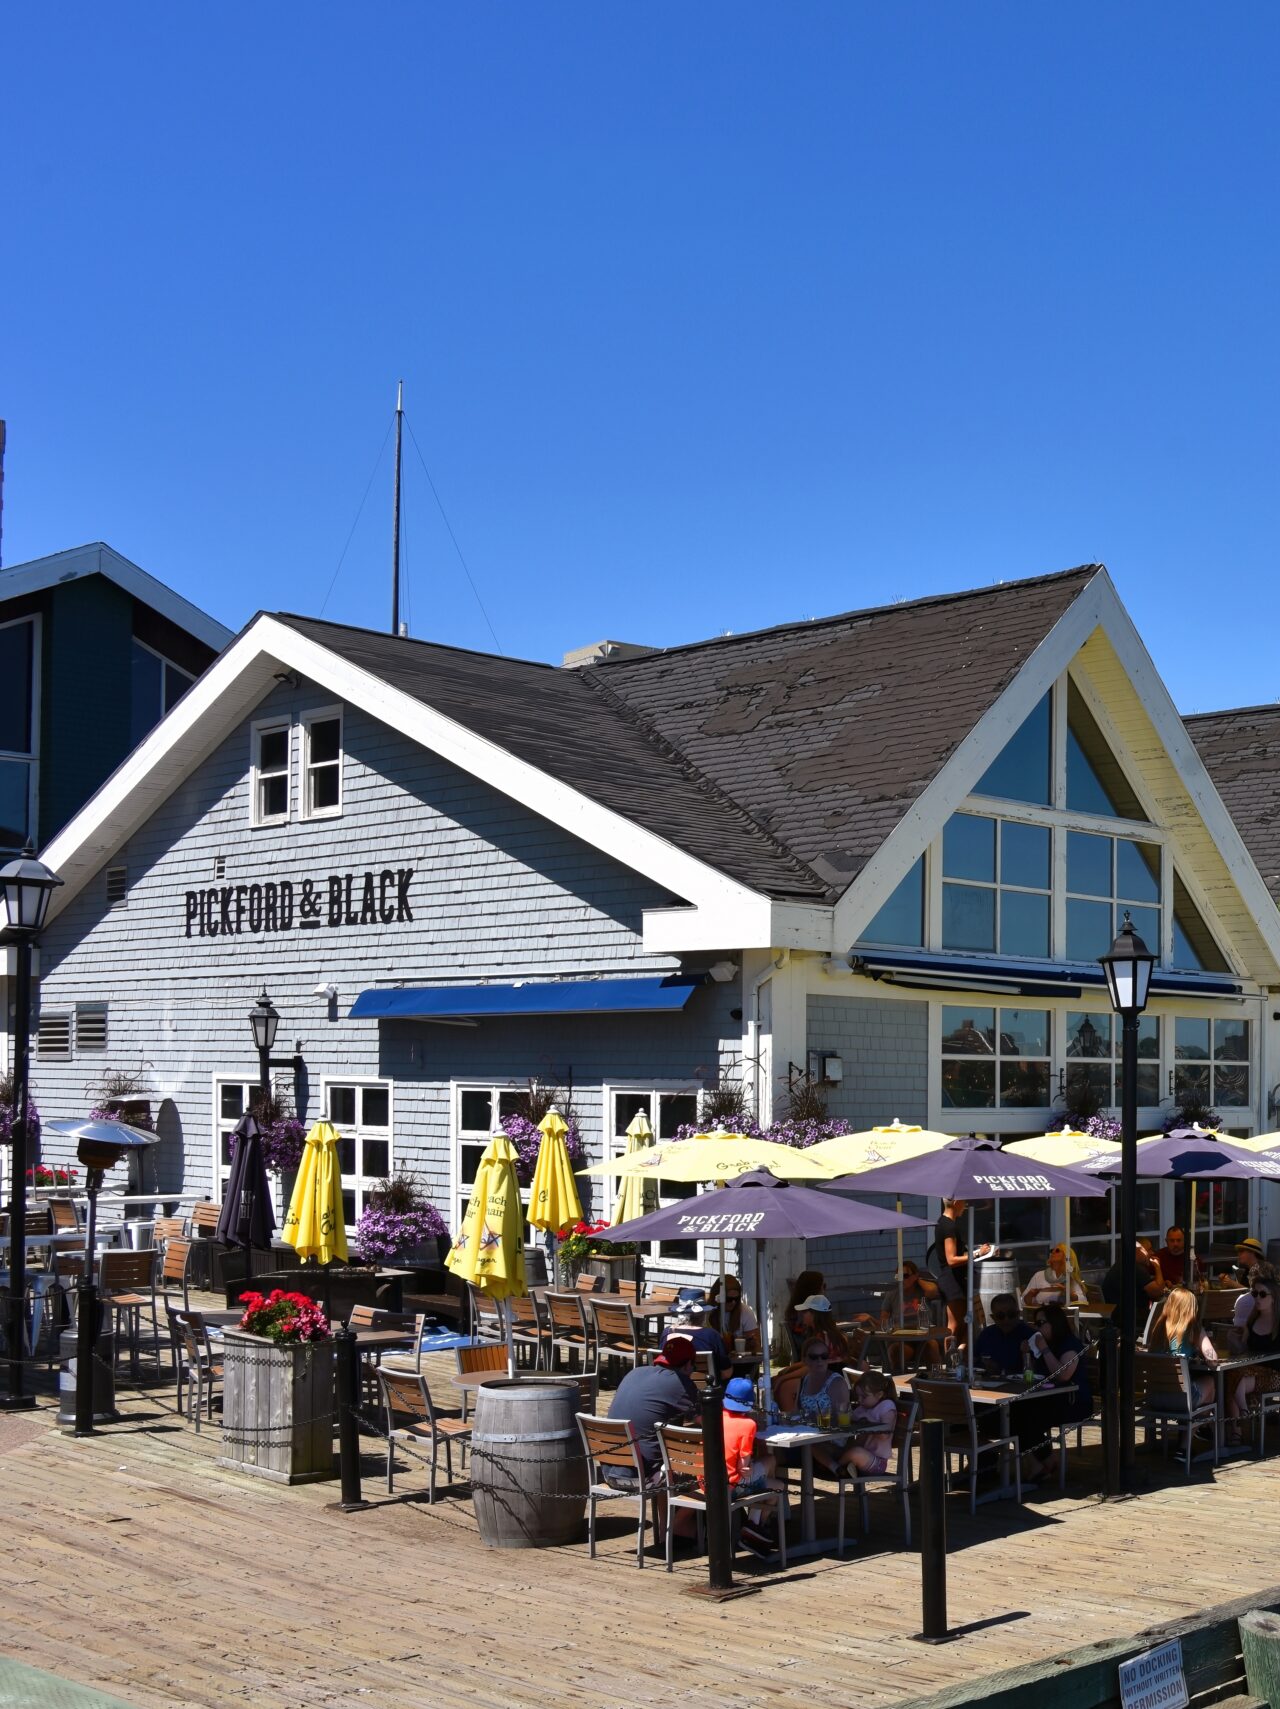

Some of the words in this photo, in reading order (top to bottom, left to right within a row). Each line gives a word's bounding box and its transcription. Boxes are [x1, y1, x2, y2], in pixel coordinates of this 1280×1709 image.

[185, 881, 294, 938] PICKFORD
[299, 879, 322, 929] &
[328, 868, 414, 928] BLACK
[973, 1175, 1049, 1184] PICKFORD
[1004, 1183, 1056, 1191] BLACK
[677, 1212, 765, 1225] PICKFORD
[700, 1221, 760, 1233] BLACK
[1123, 1667, 1137, 1685] NO
[1139, 1647, 1178, 1677] DOCKING
[1124, 1678, 1153, 1698] WITHOUT
[1153, 1663, 1181, 1684] WRITTEN
